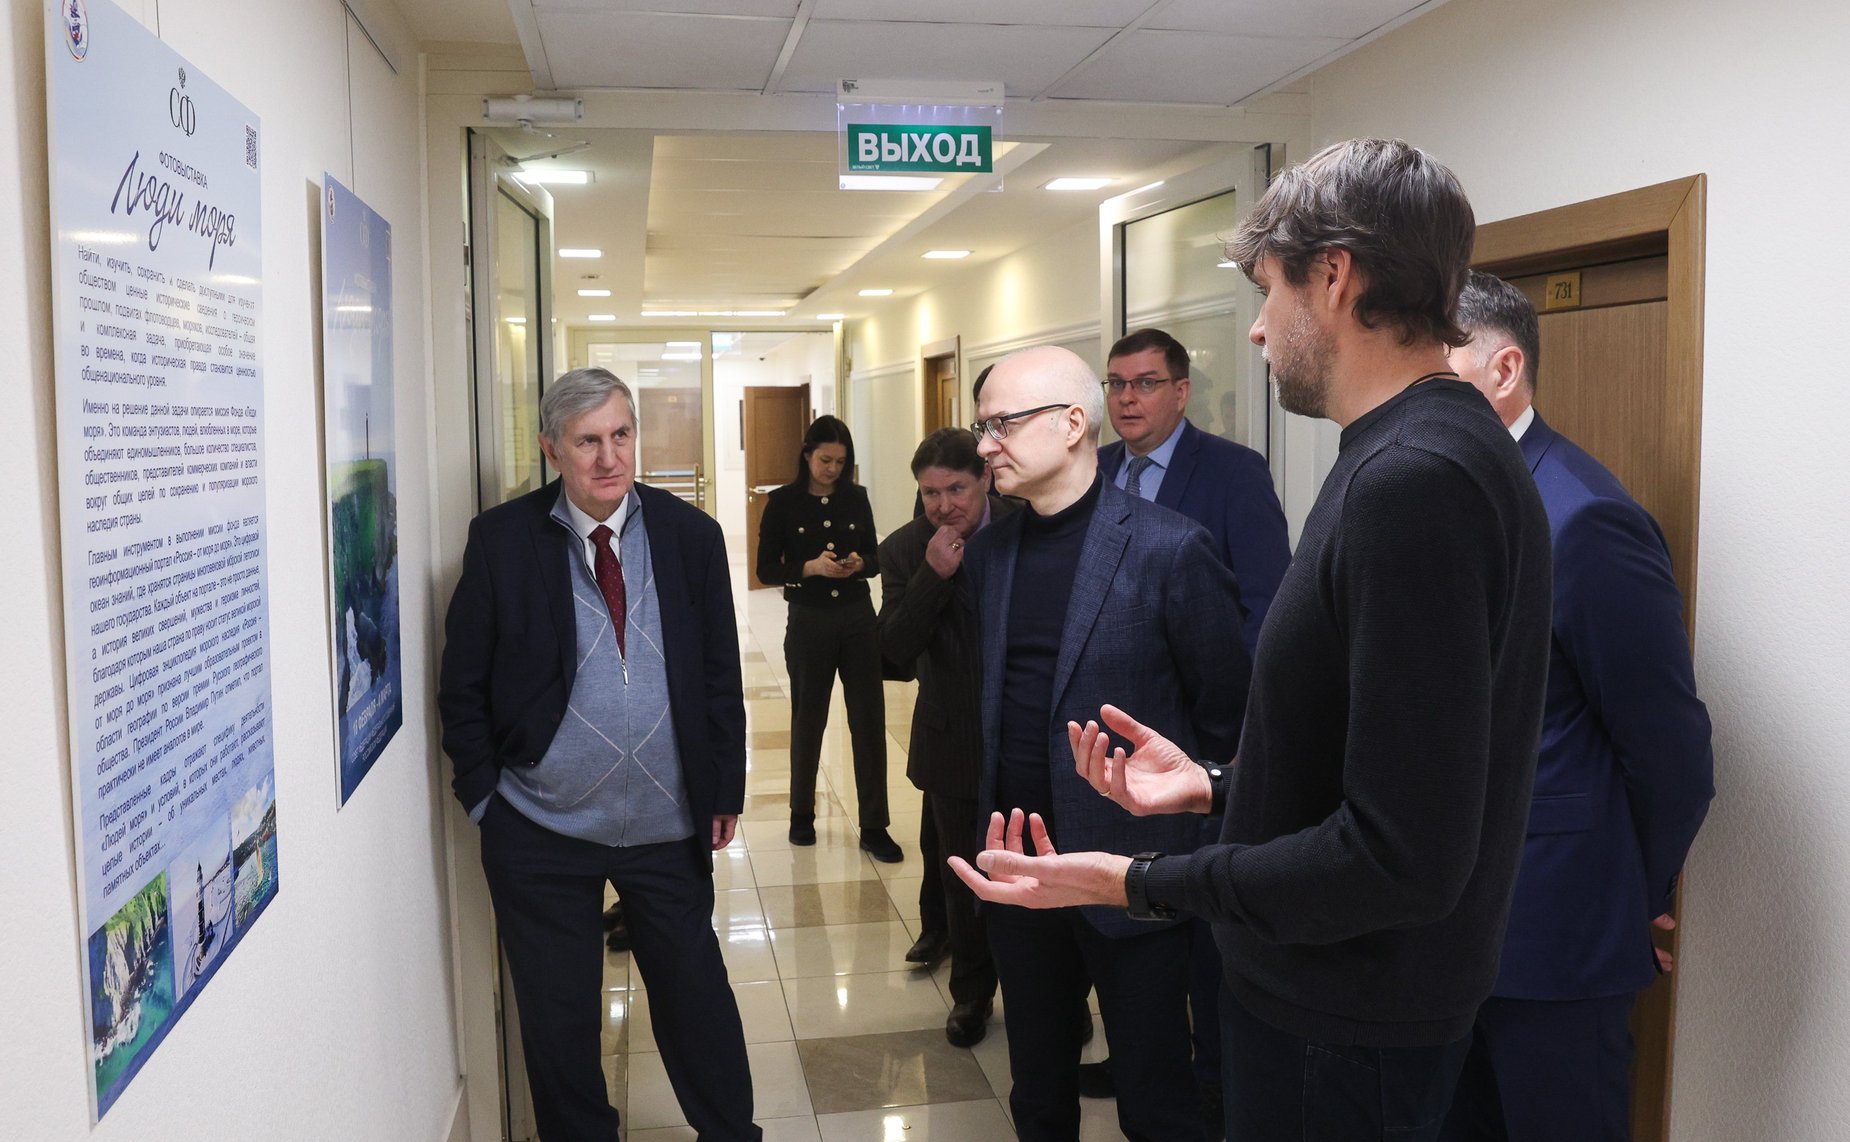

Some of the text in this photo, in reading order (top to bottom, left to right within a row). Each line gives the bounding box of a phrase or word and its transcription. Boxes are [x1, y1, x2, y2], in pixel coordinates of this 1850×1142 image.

[169, 87, 196, 137] СФ
[858, 132, 982, 167] ВЫХОД
[158, 151, 208, 190] ФОТОВЫСТАВКА
[110, 150, 237, 271] Люди моря
[106, 256, 132, 276] изучить,
[78, 269, 116, 292] обществом
[125, 284, 147, 300] ценные
[1555, 281, 1572, 300] 731
[79, 296, 142, 320] прошлом, подвигах
[96, 323, 136, 340] комплексная
[80, 344, 89, 356] во
[96, 346, 125, 363] времена,
[130, 351, 146, 366] когда
[151, 354, 186, 370] историческая
[81, 365, 167, 389] общенационального уровня.
[82, 398, 109, 413] Именно
[111, 403, 119, 414] на
[122, 403, 148, 417] решение
[150, 402, 169, 417] данной
[171, 405, 188, 417] задачи
[108, 422, 120, 436] Это
[121, 426, 147, 438] команда
[84, 445, 123, 462] объединяют
[126, 445, 182, 460] единомышленников,
[183, 442, 204, 454] большое
[84, 469, 139, 486] общественников,
[142, 462, 184, 482] представителей
[85, 494, 107, 510] вокруг
[112, 489, 133, 506] общих
[137, 486, 154, 503] целей
[86, 512, 142, 532] наследия страны.
[88, 548, 117, 565] Главным
[123, 537, 163, 556] инструментом
[175, 528, 204, 543] выполнении
[88, 558, 153, 588] геоинформационный
[154, 555, 172, 571] портал
[173, 550, 192, 563] «Россия
[89, 596, 109, 612] океан
[111, 585, 135, 605] знаний,
[136, 584, 146, 598] где
[147, 576, 171, 595] хранятся
[172, 568, 195, 586] страницы
[90, 617, 114, 636] нашего
[115, 604, 152, 626] государства.
[153, 593, 174, 612] Каждый
[174, 589, 191, 604] объект
[92, 658, 126, 682] благодаря
[126, 646, 151, 666] которым
[152, 640, 166, 655] наша
[167, 631, 184, 648] страна
[101, 635, 127, 655] история
[131, 624, 154, 642] великих
[94, 682, 124, 709] державы.
[129, 664, 158, 688] Цифровая
[162, 646, 196, 671] энциклопедия
[106, 705, 122, 722] моря
[125, 699, 134, 714] до
[136, 689, 154, 706] моря»
[157, 673, 181, 696] признана
[183, 662, 202, 682] лучшим
[96, 727, 122, 752] области
[127, 707, 157, 733] географии
[171, 688, 189, 707] версии
[192, 677, 209, 696] премии
[97, 746, 130, 775] общества.
[133, 725, 162, 753] Президент
[165, 712, 183, 731] России
[185, 696, 209, 719] Владимир
[98, 764, 136, 800] практически
[145, 747, 162, 766] имеет
[163, 731, 186, 754] аналогов
[99, 783, 151, 829] Представленные
[159, 765, 176, 785] кадры
[183, 742, 206, 767] отражают
[101, 821, 126, 851] «Людей
[129, 809, 147, 830] моря»
[102, 850, 122, 877] целые
[129, 825, 152, 852] истории
[103, 863, 134, 897] памятных
